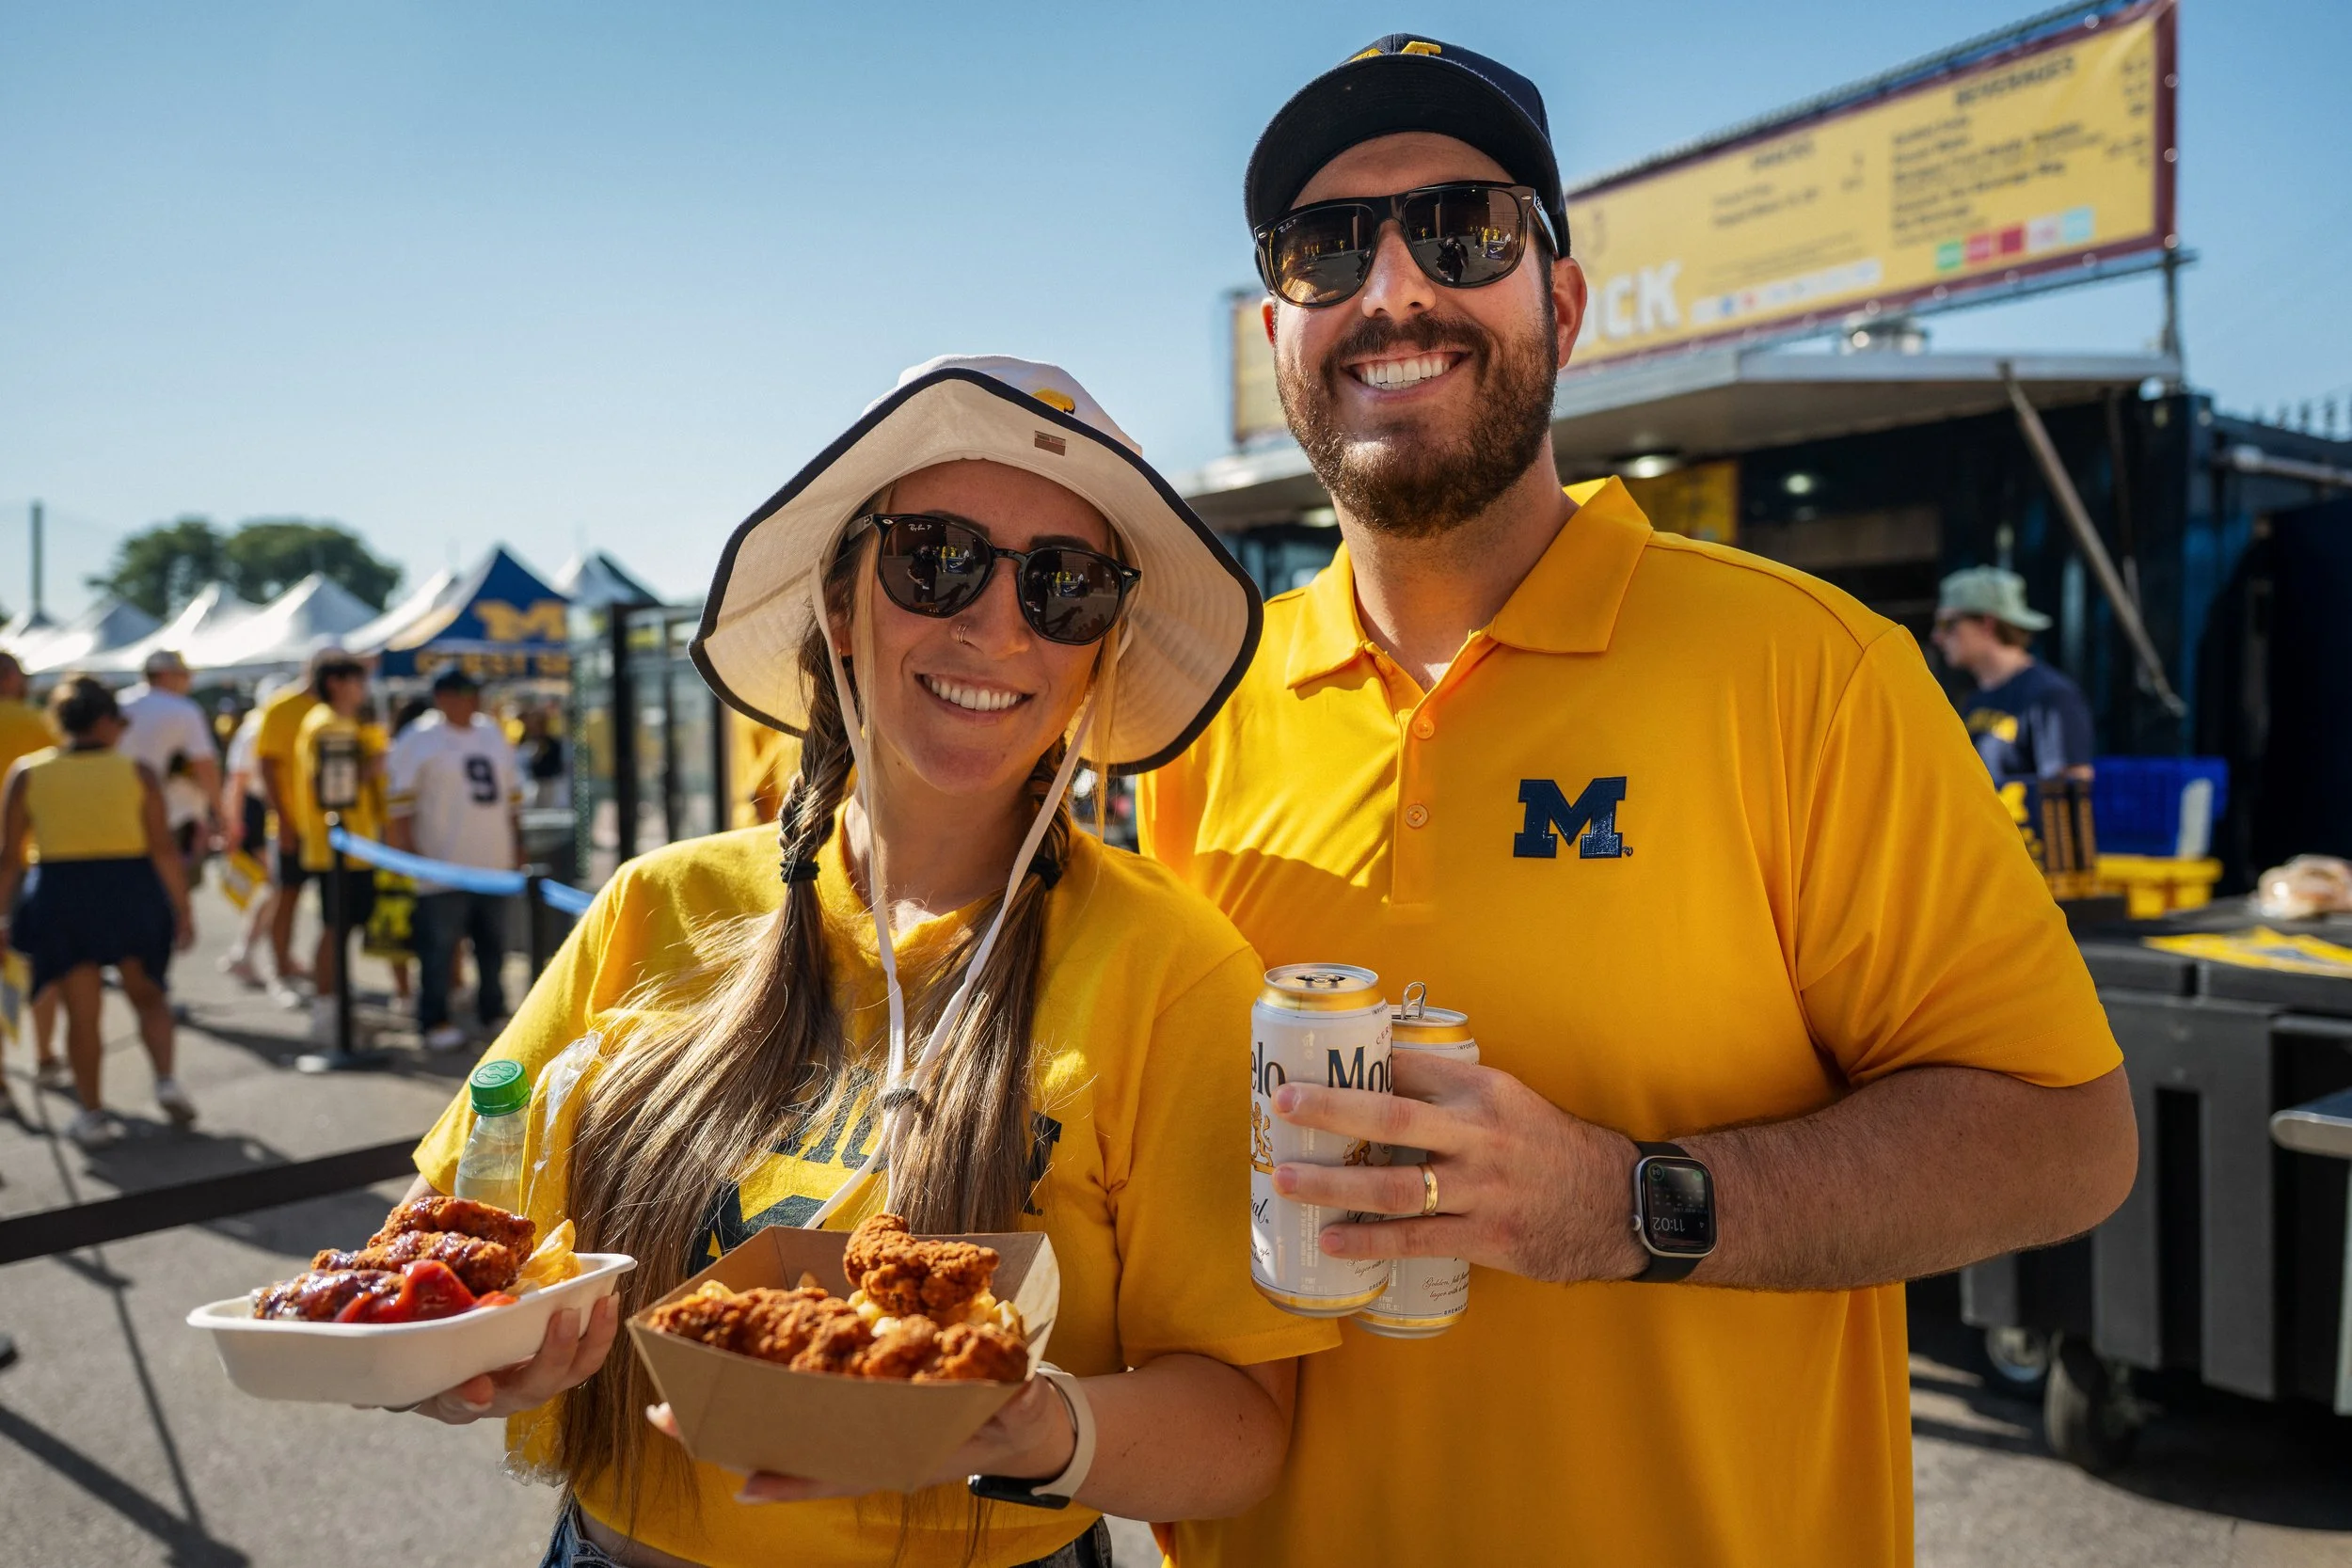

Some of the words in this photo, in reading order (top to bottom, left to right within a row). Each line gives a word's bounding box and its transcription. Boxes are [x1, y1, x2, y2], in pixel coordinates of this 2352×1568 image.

[473, 600, 568, 641] M
[465, 754, 499, 804] 9
[1513, 776, 1627, 859] M
[1652, 1217, 1686, 1232] 11:02
